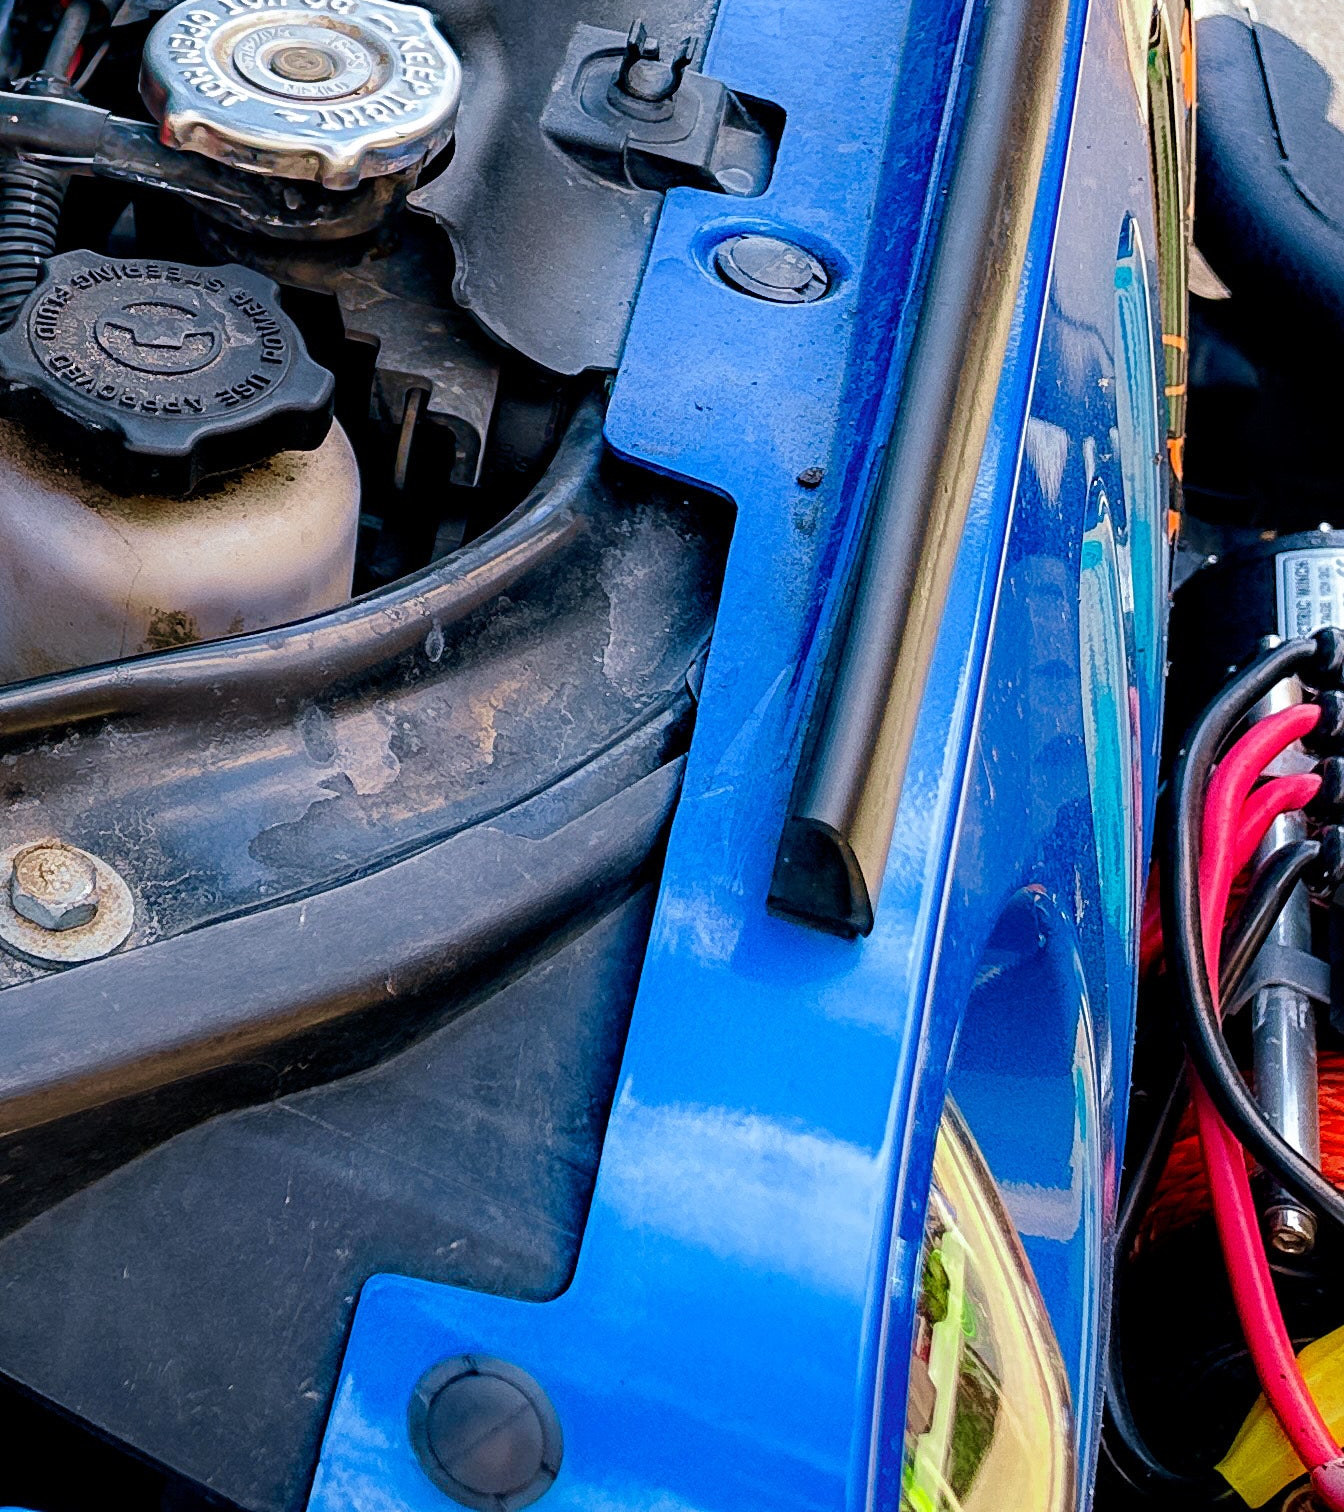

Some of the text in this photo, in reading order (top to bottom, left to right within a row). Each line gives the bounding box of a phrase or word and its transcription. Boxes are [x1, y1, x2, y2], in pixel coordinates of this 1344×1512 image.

[167, 9, 221, 65] OPEN
[393, 35, 437, 93] KEEP
[179, 65, 250, 107] HOT
[315, 97, 421, 131] TIGHT
[35, 262, 285, 365] POWER STEERING FLUID
[50, 353, 271, 415] USE APPROVED
